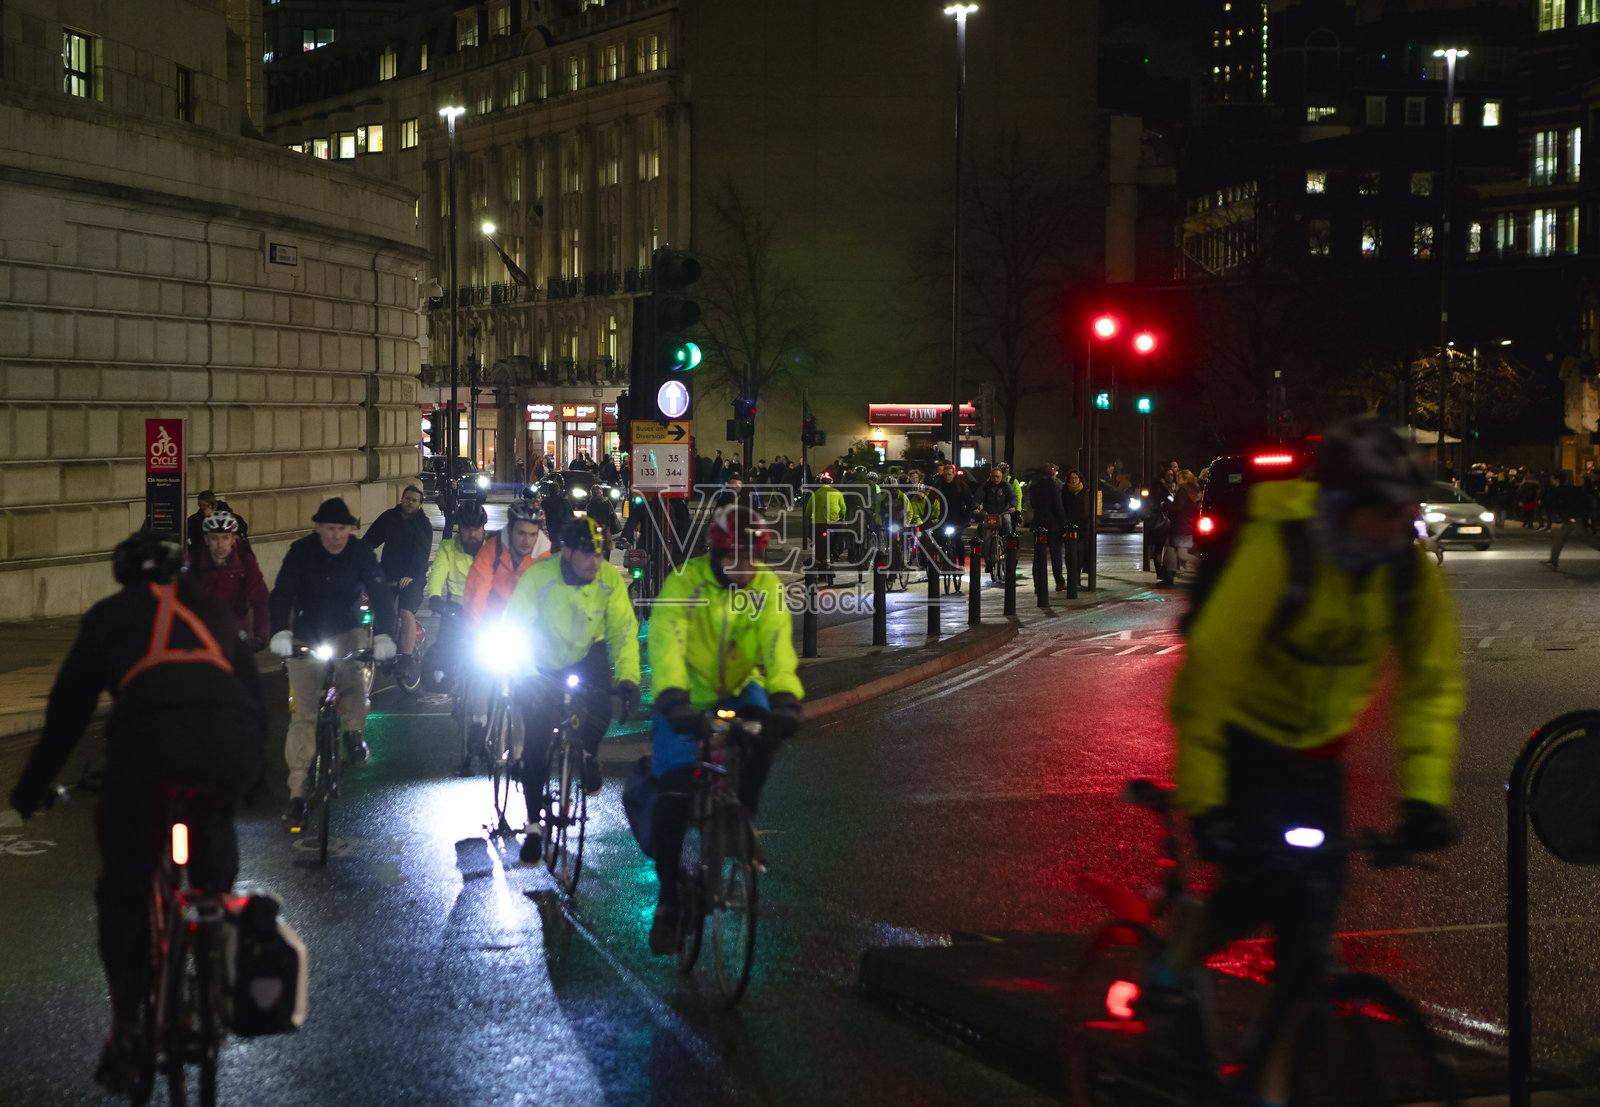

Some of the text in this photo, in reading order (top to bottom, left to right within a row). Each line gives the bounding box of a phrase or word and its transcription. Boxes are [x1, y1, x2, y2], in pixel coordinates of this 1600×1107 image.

[909, 408, 937, 419] EL VINO
[151, 456, 178, 465] CYCLE
[668, 454, 679, 463] 35
[641, 468, 655, 477] 133
[665, 468, 682, 477] 344
